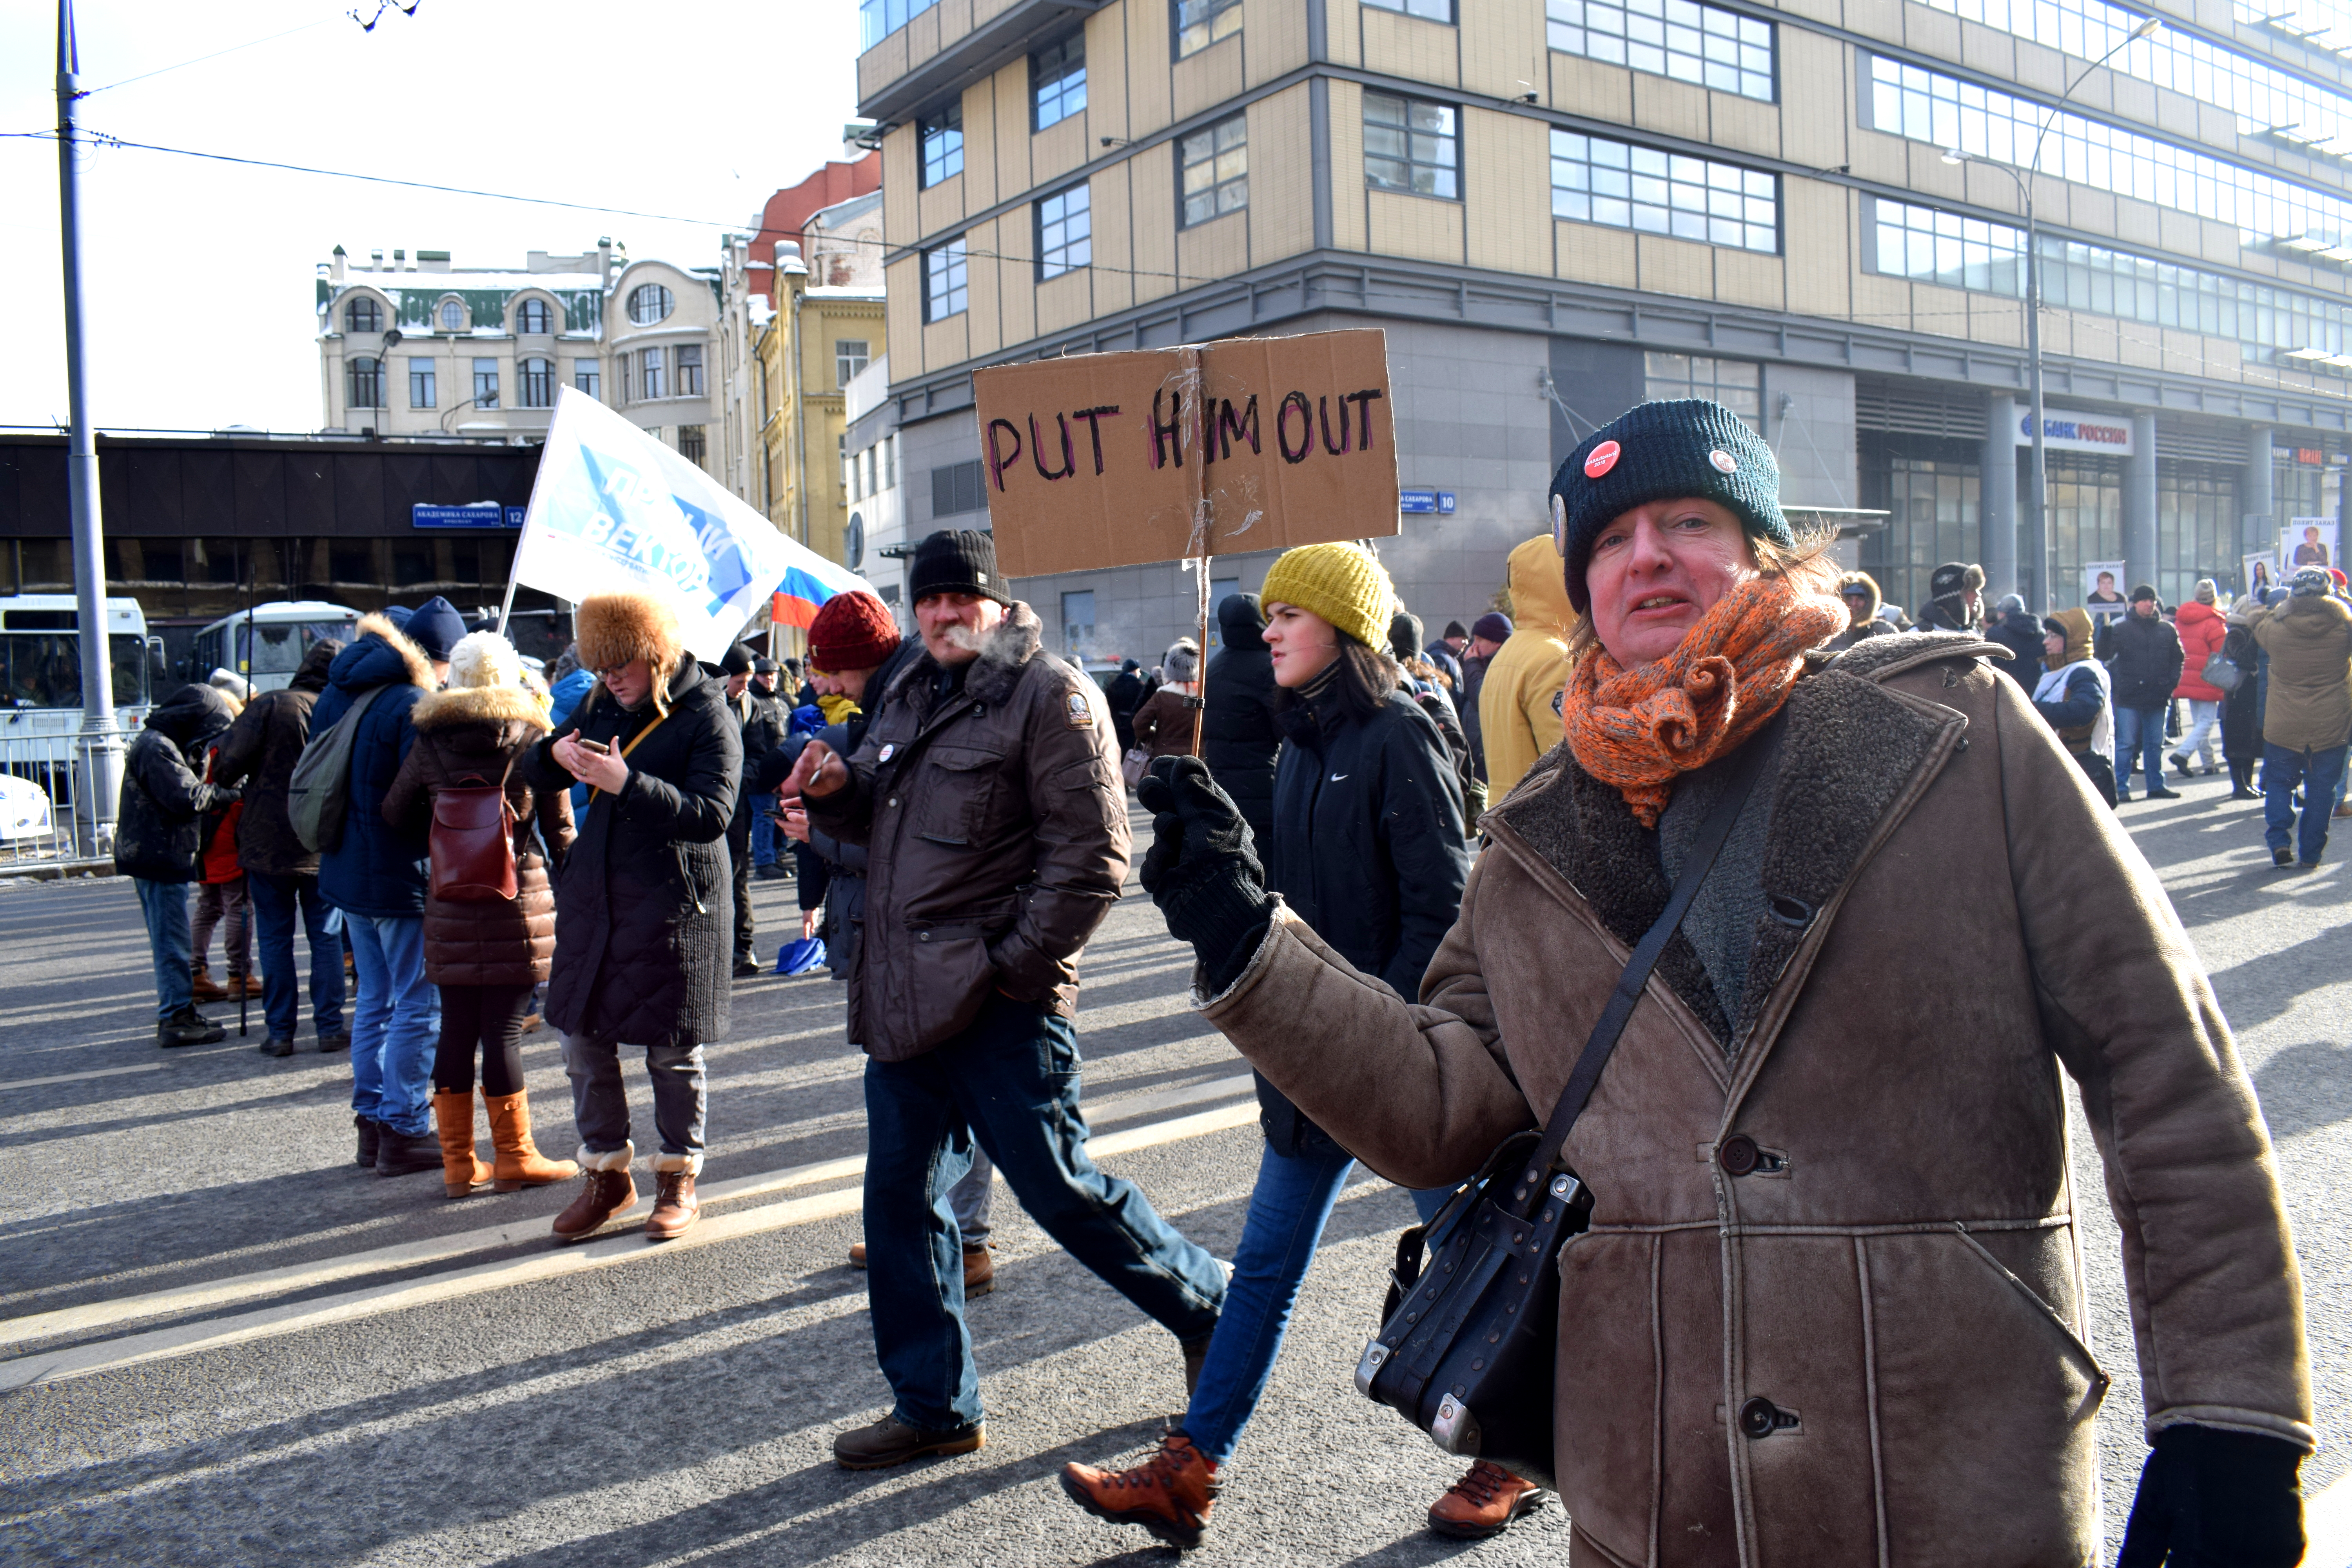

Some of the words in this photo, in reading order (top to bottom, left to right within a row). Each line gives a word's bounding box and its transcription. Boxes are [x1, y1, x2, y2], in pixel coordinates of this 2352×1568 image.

[988, 405, 1123, 493] PUT
[1147, 389, 1260, 470] HIM
[1278, 389, 1382, 464] OUT
[2043, 419, 2076, 439] БАНК
[2079, 423, 2126, 445] РОССИЯ
[1586, 450, 1617, 466] НАВАЛЬНЫЙ
[1443, 496, 1454, 509] 10
[510, 512, 523, 523] 12
[579, 511, 708, 590] ВЕКТОР
